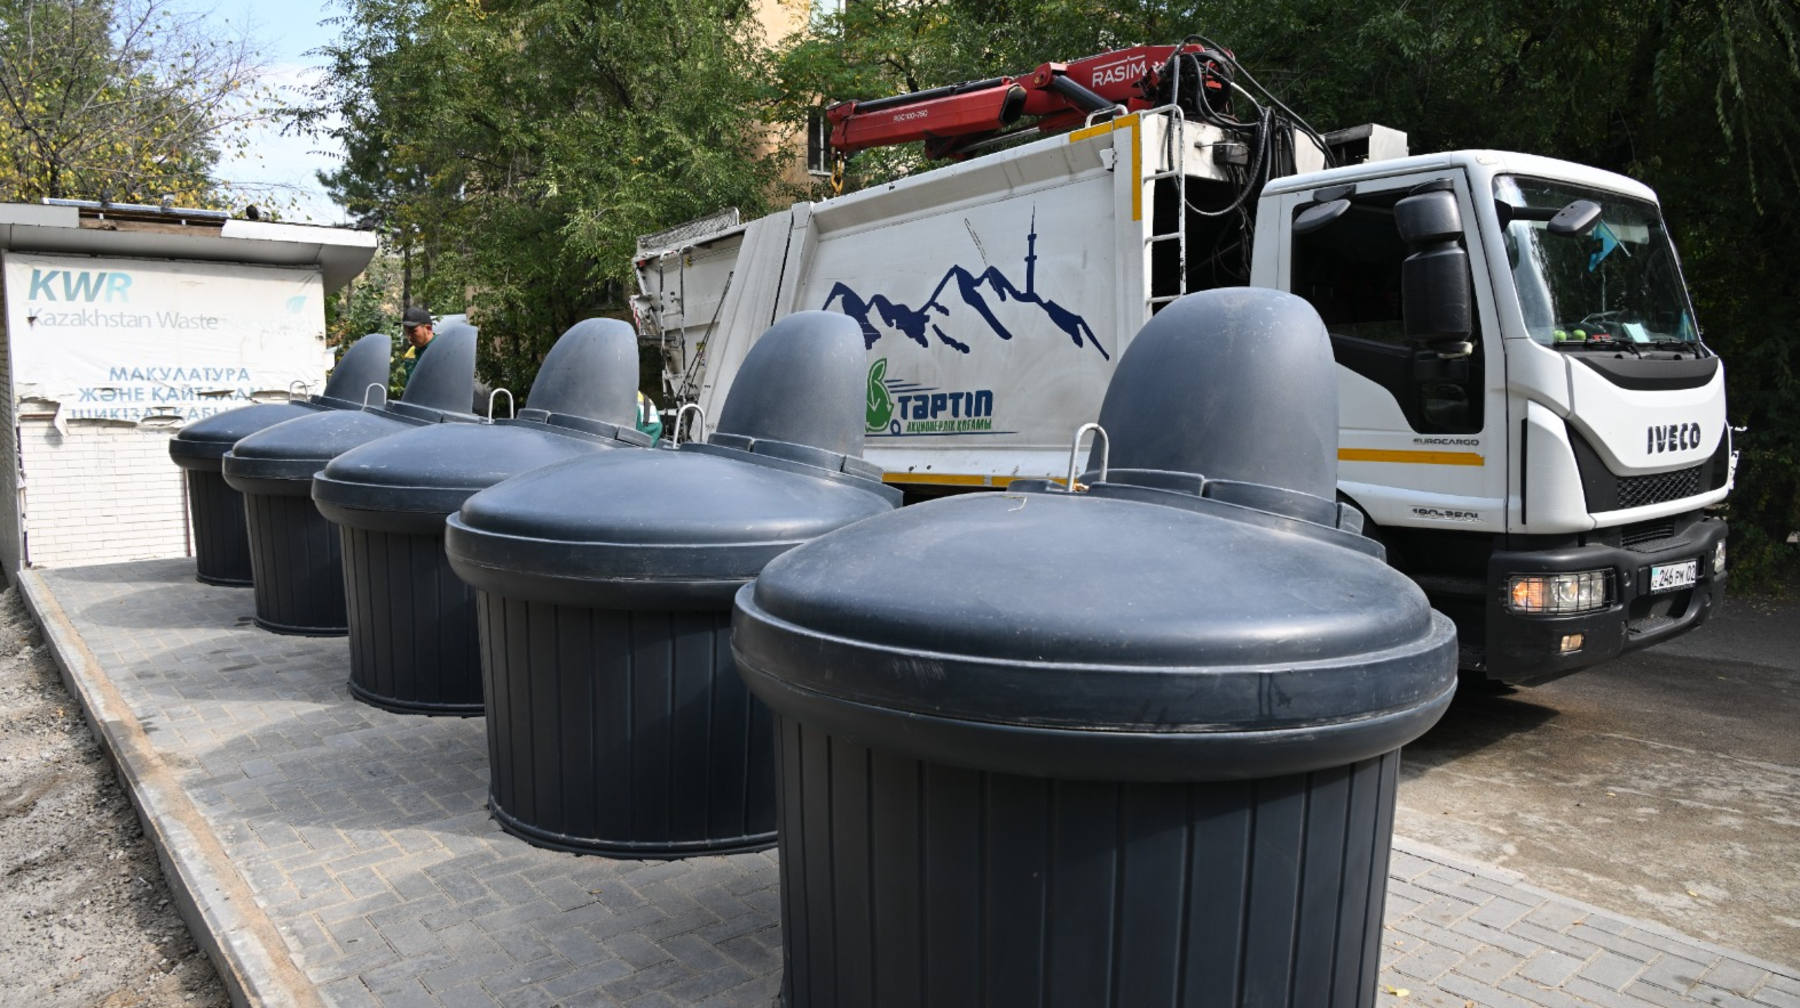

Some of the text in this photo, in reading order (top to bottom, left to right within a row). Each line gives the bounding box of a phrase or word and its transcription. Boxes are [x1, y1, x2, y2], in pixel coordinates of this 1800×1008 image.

[1092, 60, 1166, 88] RASIM
[28, 268, 132, 302] KWR
[28, 307, 152, 328] Kazakhstan
[157, 311, 218, 330] Waste
[109, 366, 250, 381] МАКУЛАТУРА
[79, 387, 144, 402] ЖӘНЕ
[1412, 438, 1480, 446] EUROCARGO
[1647, 422, 1701, 455] IVECO
